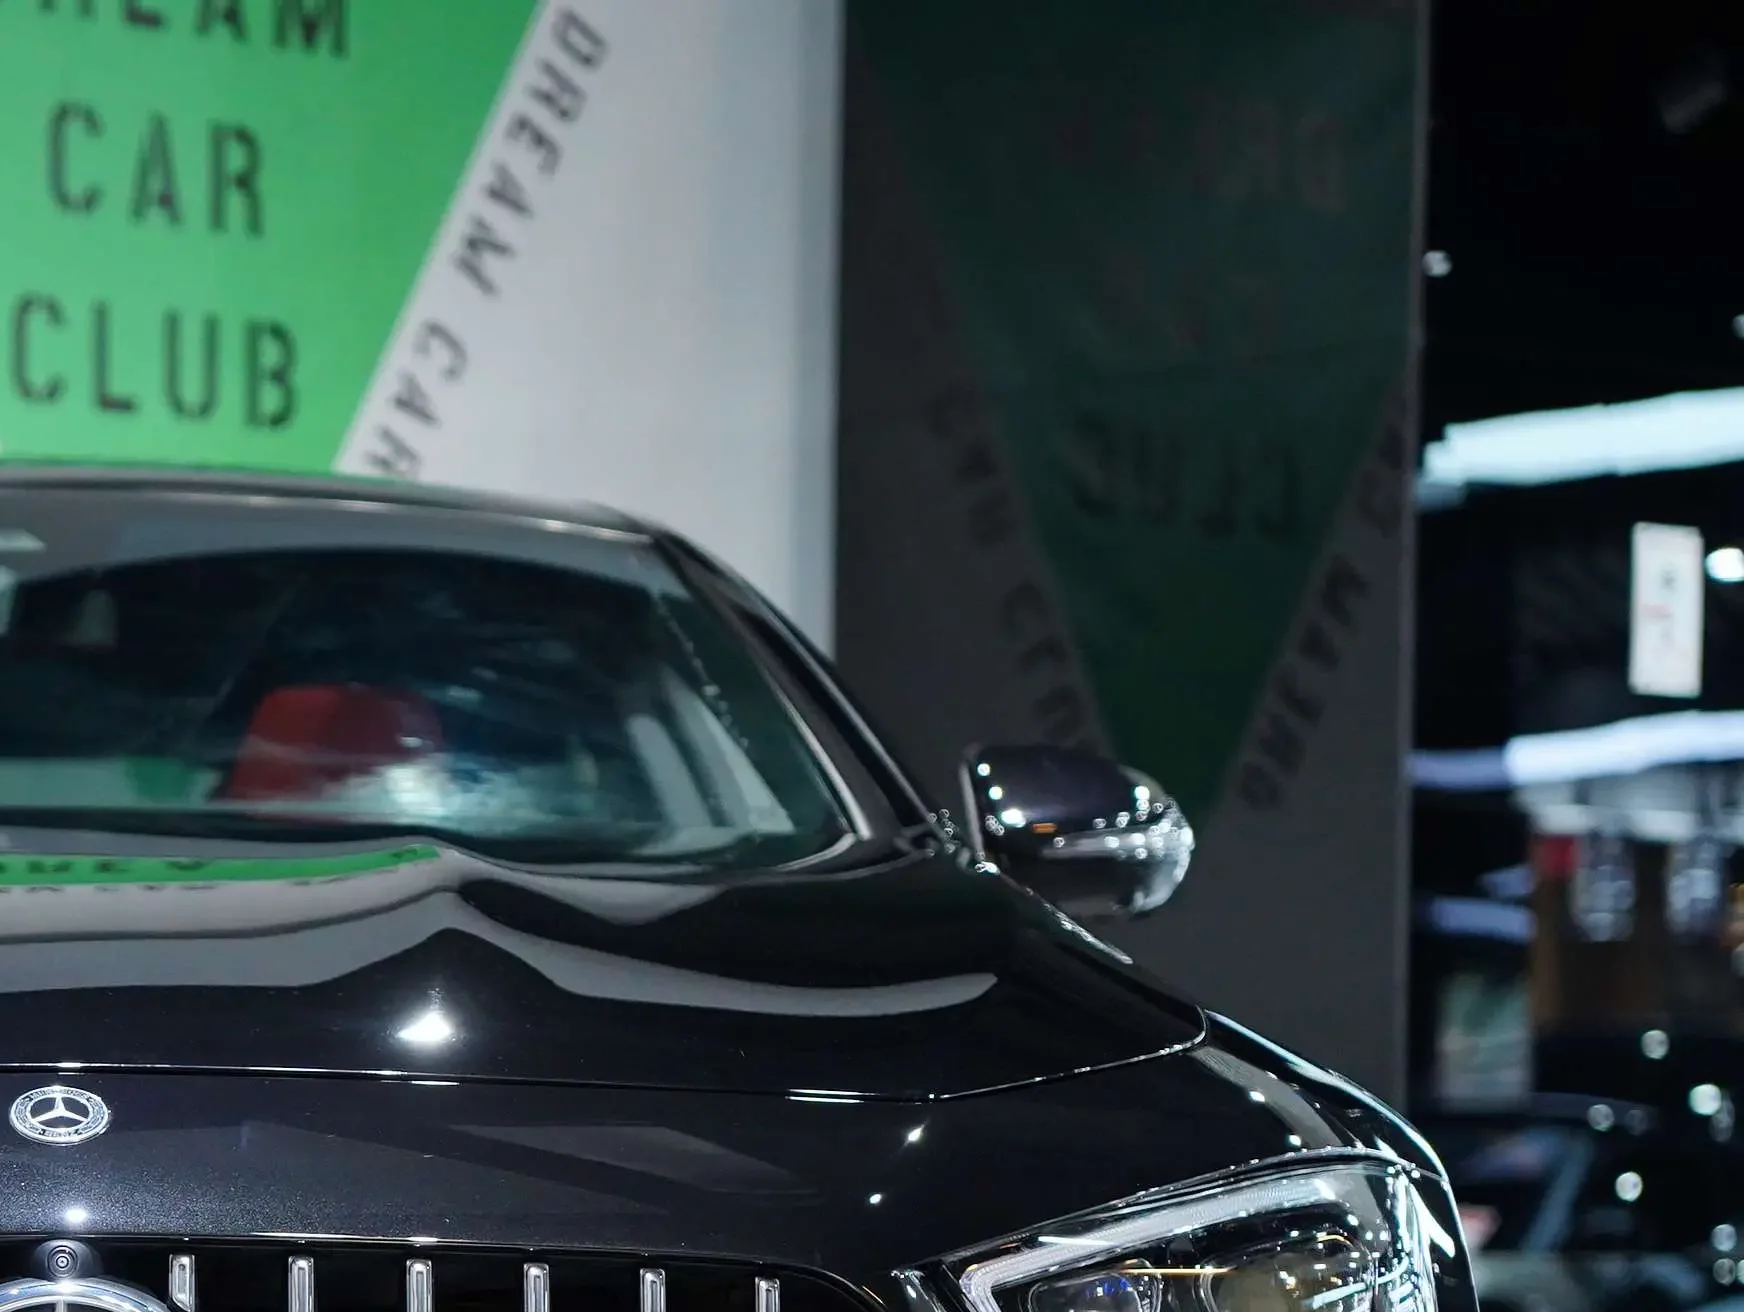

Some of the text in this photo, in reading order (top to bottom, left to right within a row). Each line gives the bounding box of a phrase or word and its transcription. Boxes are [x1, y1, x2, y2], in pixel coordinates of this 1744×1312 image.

[46, 102, 264, 236] CAR
[448, 8, 611, 299] DREAM
[9, 293, 300, 430] CLUB
